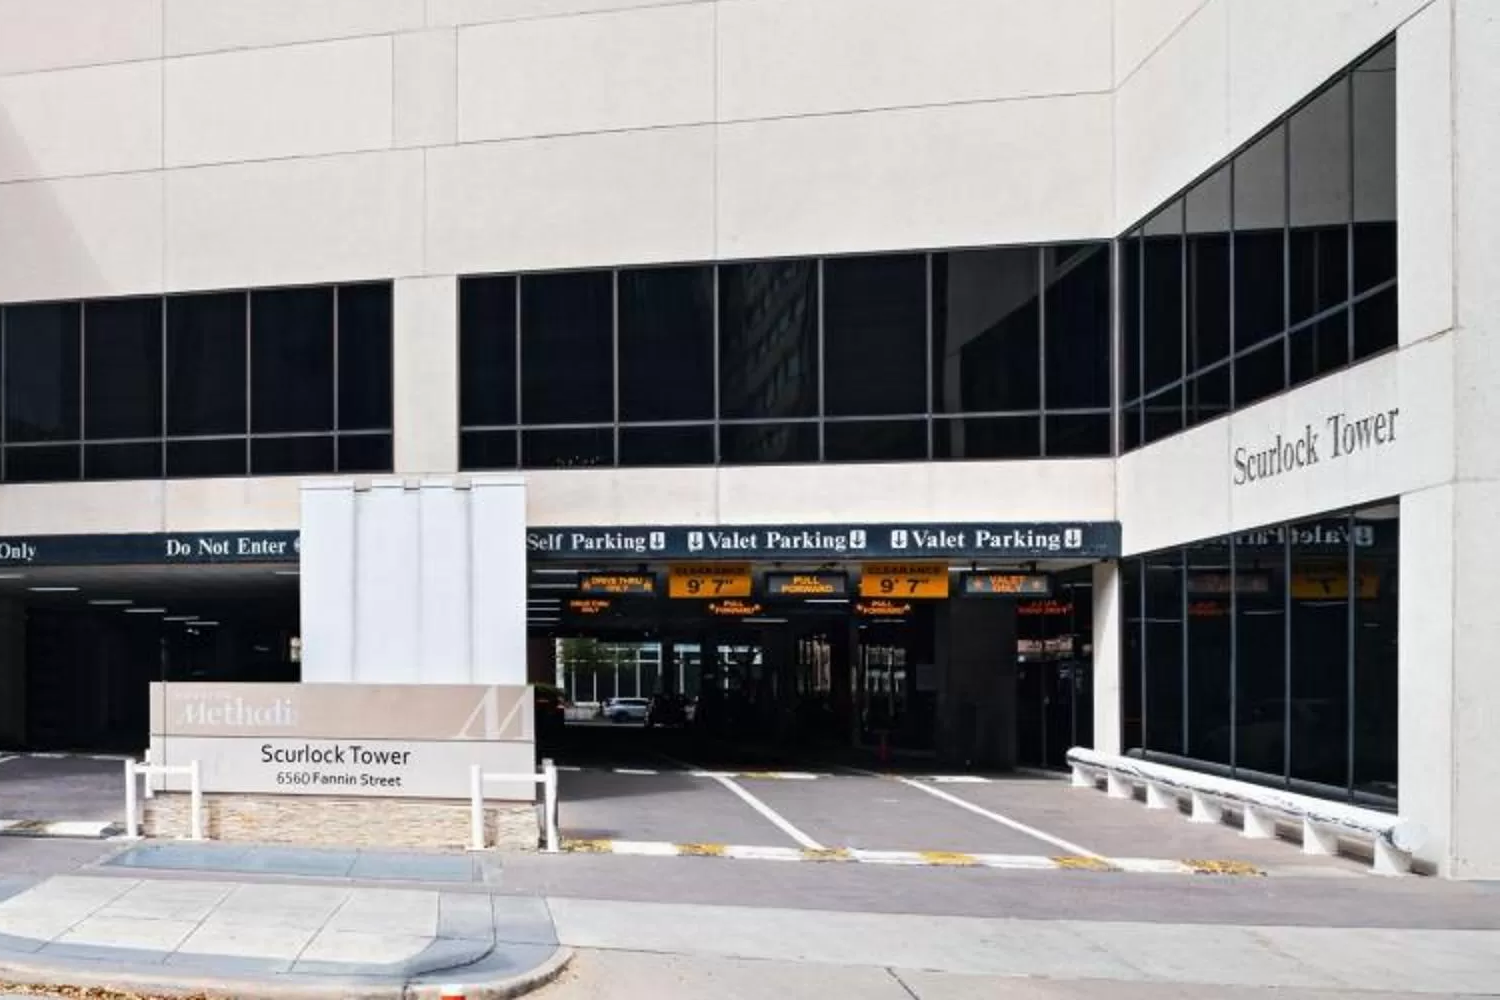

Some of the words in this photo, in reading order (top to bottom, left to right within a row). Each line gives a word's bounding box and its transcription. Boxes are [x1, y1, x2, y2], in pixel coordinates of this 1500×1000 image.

[1234, 424, 1319, 486] Scurlock
[1326, 408, 1400, 459] Tower
[166, 539, 191, 556] Do
[198, 538, 229, 555] Not
[237, 537, 287, 555] Enter
[526, 532, 564, 550] Self
[571, 532, 646, 552] Parking
[708, 531, 758, 549] Valet
[767, 531, 847, 551] Parking
[912, 530, 965, 549] Valet
[975, 529, 1061, 550] Parking
[793, 576, 821, 584] PULL
[261, 743, 345, 765] Scurlock
[350, 745, 412, 766] Tower
[276, 771, 311, 786] 6560
[313, 772, 357, 786] Fannin
[360, 774, 403, 788] Street
